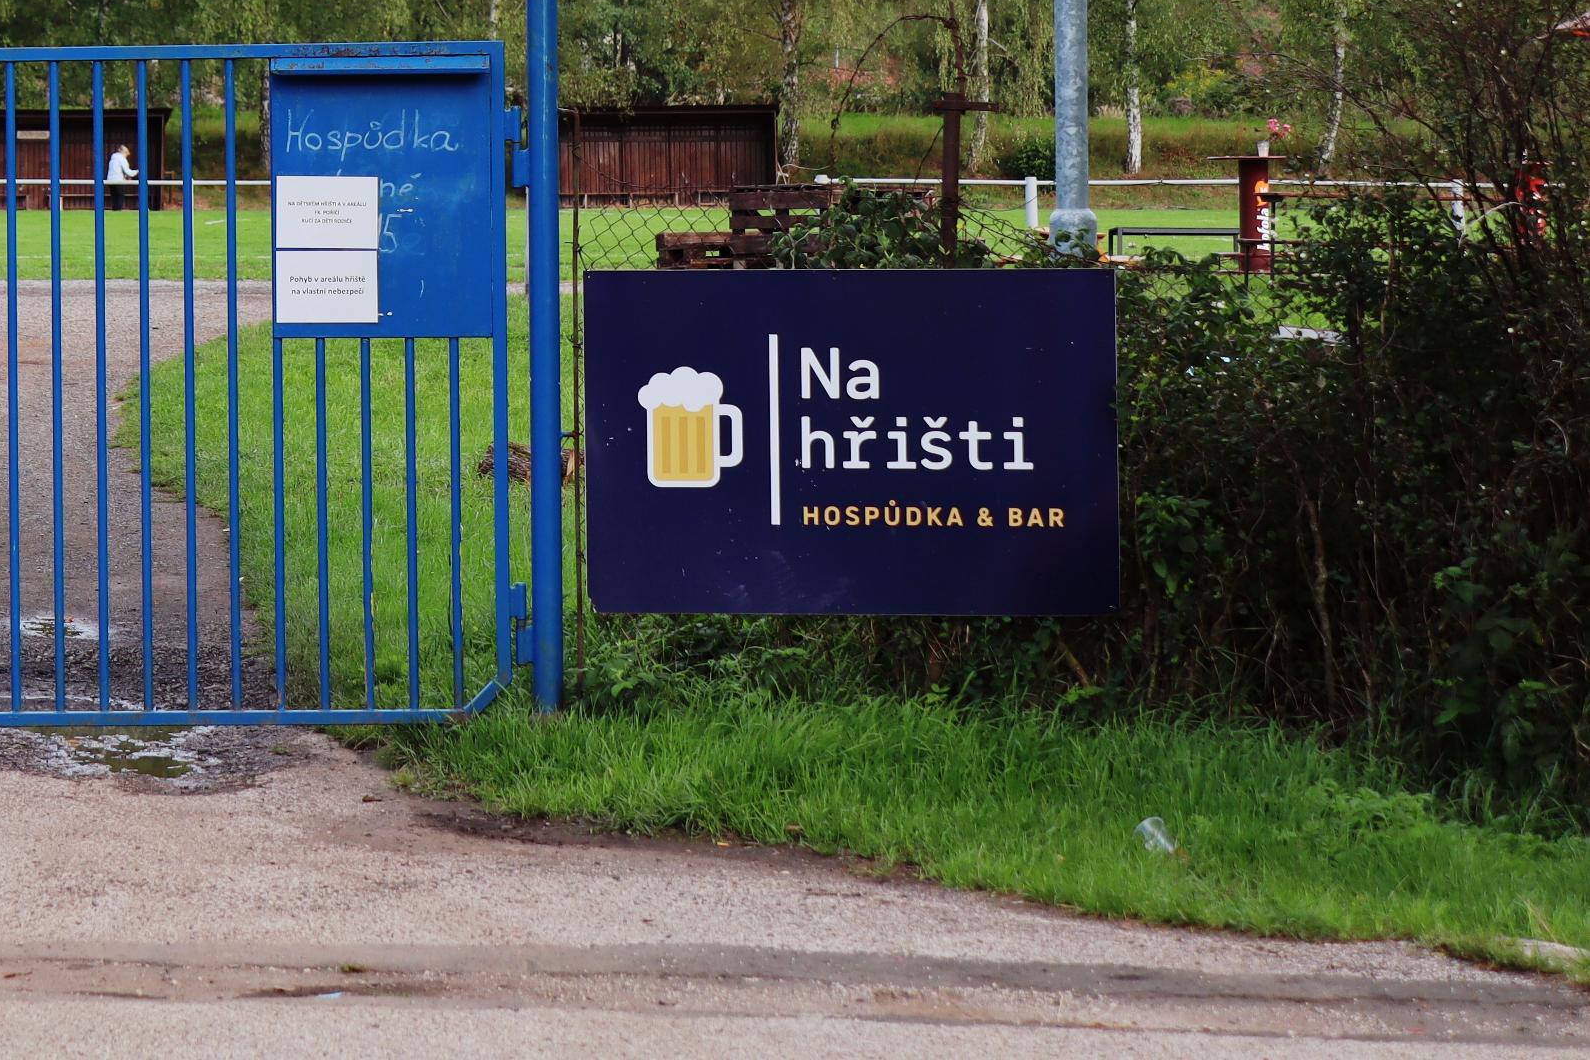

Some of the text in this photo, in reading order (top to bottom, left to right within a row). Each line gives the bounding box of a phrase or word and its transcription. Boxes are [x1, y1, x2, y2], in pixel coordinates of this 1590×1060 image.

[286, 108, 459, 162] Hospůdka
[289, 275, 312, 284] Pohyb
[302, 287, 326, 295] vlastní
[327, 287, 365, 296] nebezpečí
[800, 347, 880, 400] Na
[800, 416, 1034, 471] hřišti
[802, 499, 1065, 528] HOSPŮDKA & BAR
